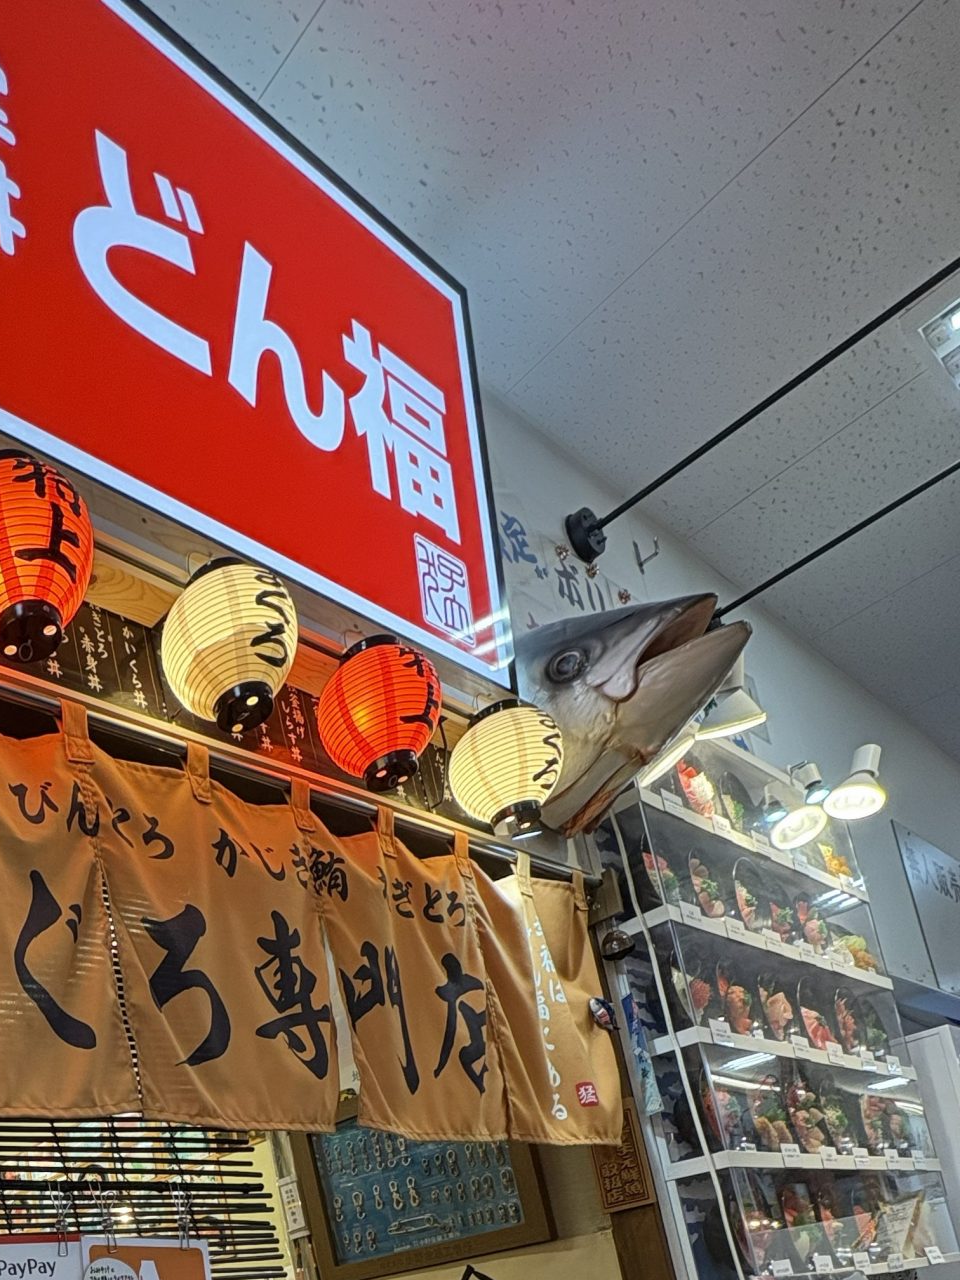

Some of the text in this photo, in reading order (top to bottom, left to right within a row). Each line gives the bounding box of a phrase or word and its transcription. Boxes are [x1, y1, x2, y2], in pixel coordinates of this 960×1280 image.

[72, 129, 462, 546] どん福
[7, 780, 175, 860] びんとろ
